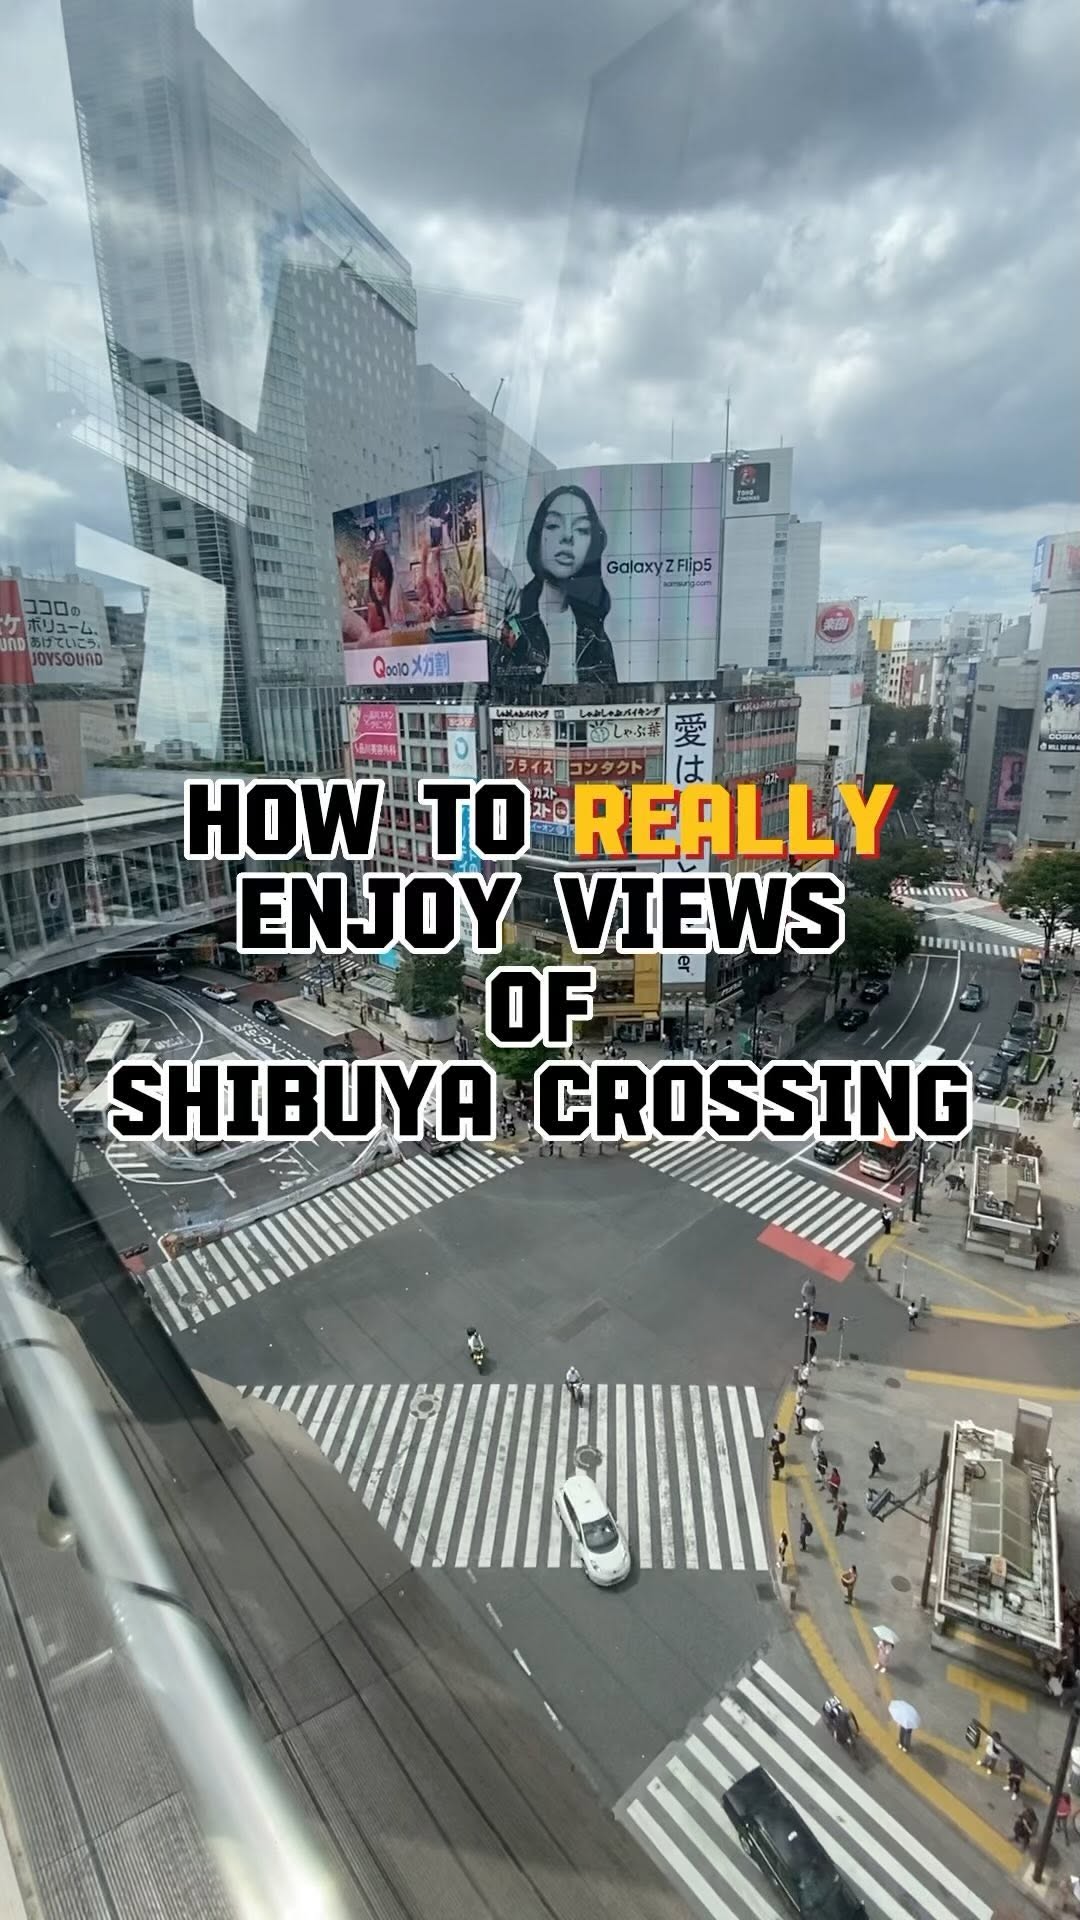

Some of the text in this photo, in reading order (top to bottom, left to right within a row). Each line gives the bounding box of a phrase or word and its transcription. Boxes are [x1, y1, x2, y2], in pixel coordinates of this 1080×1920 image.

[606, 557, 713, 577] Galaxy Z Flip5
[663, 580, 712, 588] samsung.com
[23, 598, 81, 617] ココロの
[0, 613, 21, 636] ケ
[28, 616, 98, 636] ボリューム、
[32, 651, 104, 668] JOYSOUND
[373, 650, 450, 679] Qoo10 メガ割
[578, 706, 662, 719] しゃぶしゃぶバイキング
[520, 722, 551, 740] しゃぶ葉
[613, 721, 662, 740] しゃぶ葉
[569, 759, 643, 777] コンタクト
